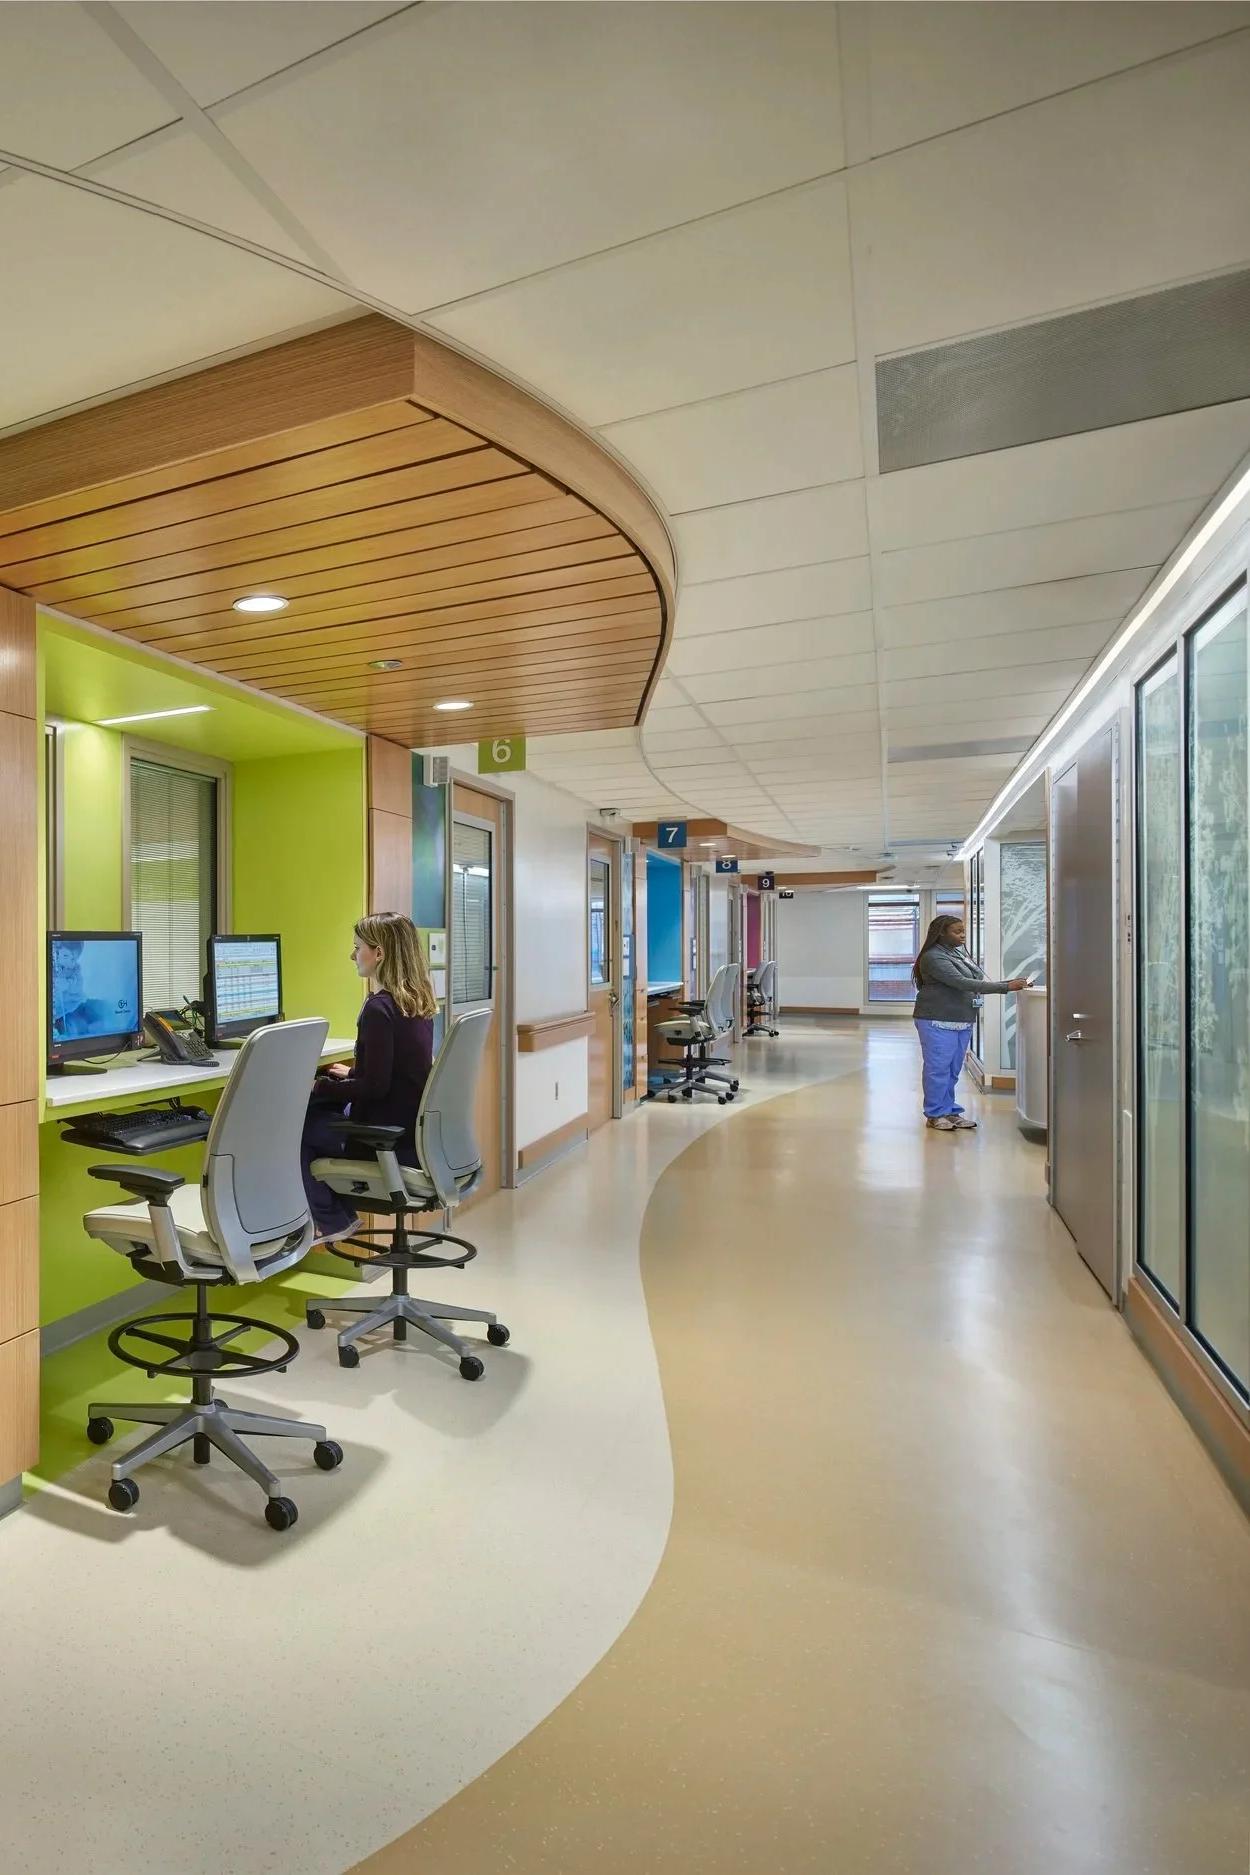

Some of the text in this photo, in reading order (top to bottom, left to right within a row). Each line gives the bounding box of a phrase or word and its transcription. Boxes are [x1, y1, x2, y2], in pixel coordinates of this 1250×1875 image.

[492, 739, 511, 763] 6
[666, 827, 678, 843] 7
[722, 860, 732, 869] 8
[762, 878, 770, 888] 9
